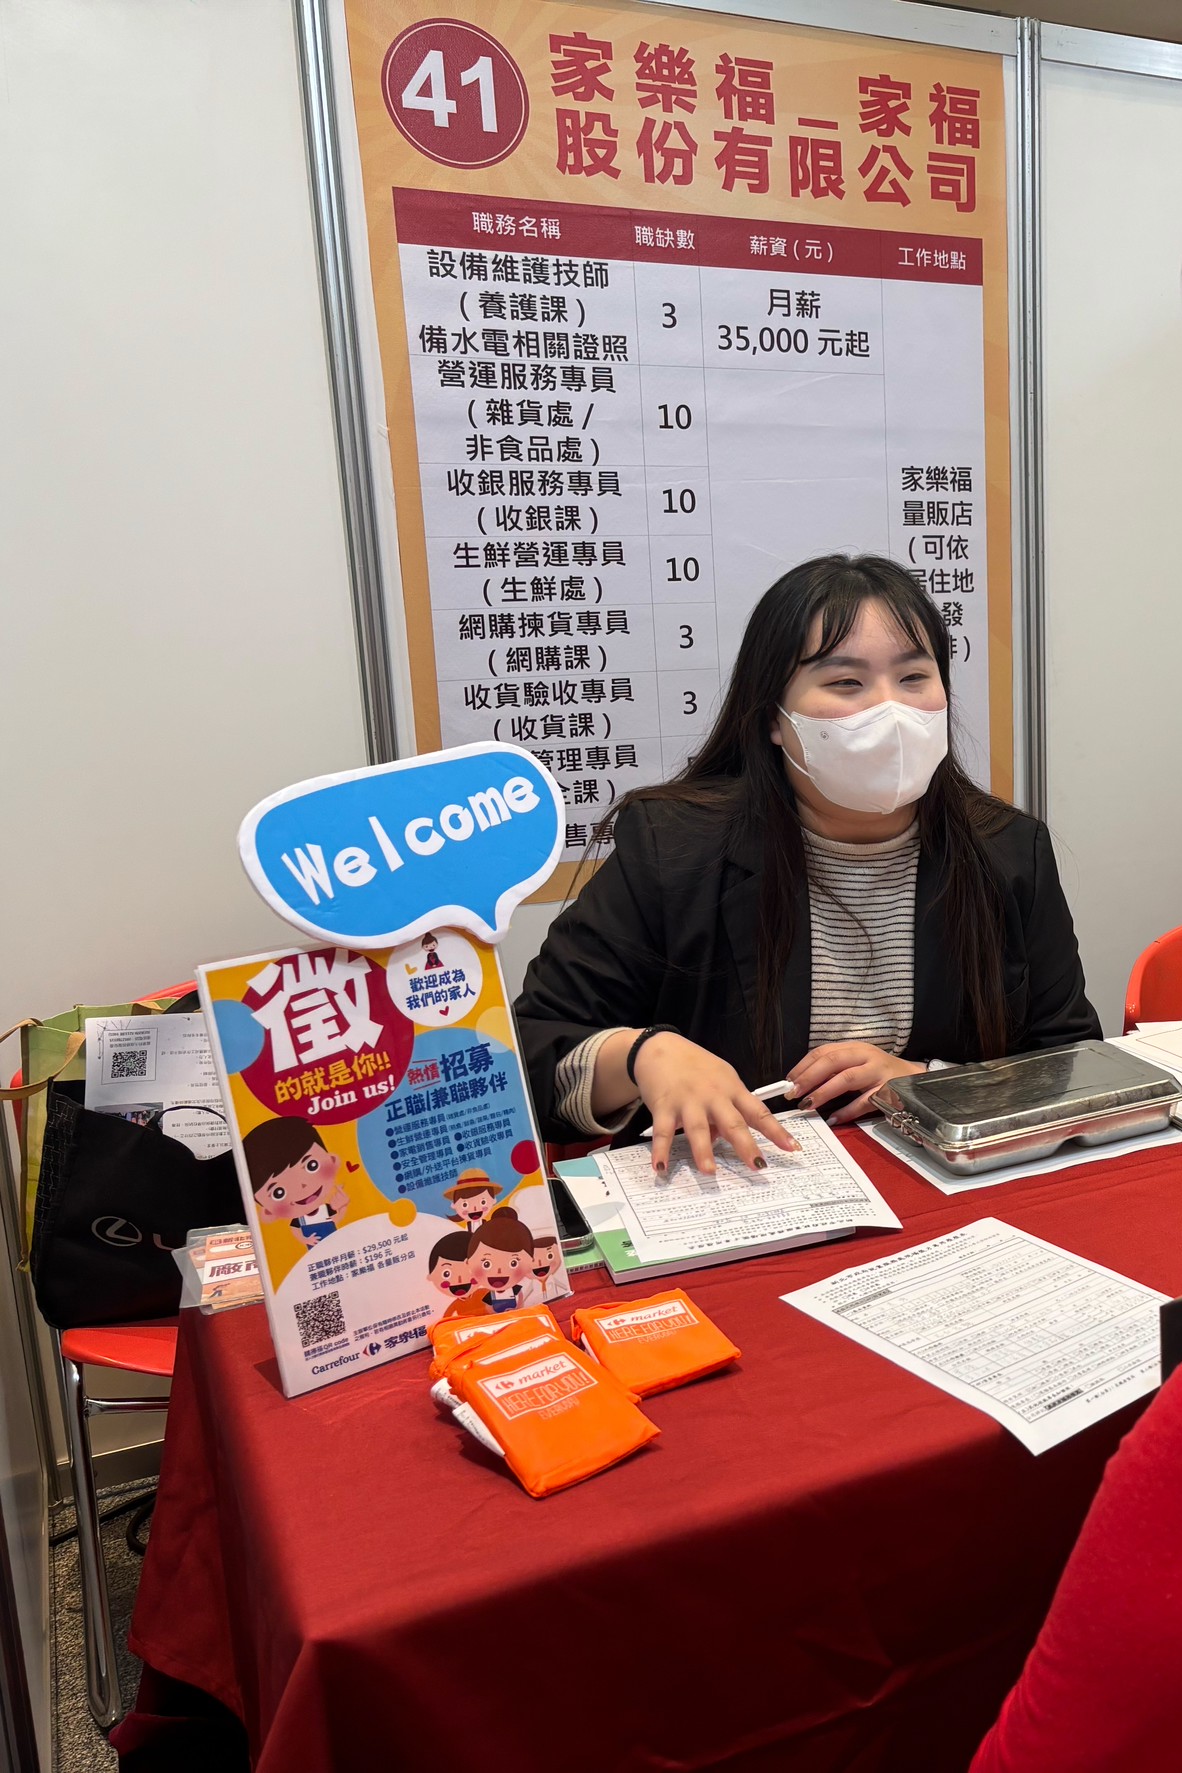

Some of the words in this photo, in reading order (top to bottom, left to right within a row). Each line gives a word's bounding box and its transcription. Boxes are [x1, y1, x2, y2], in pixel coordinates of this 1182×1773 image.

[401, 50, 499, 133] 41
[555, 108, 977, 213] 股份有限公司
[472, 211, 562, 240] 職務名稱
[634, 225, 696, 250] 職缺數
[427, 249, 610, 290] 設備維護技師
[897, 247, 967, 271] 工作地點
[459, 290, 586, 328] (養護課)
[662, 303, 678, 329] 3
[767, 290, 821, 320] 月薪
[419, 326, 629, 363] 備水電相關證照
[717, 326, 810, 357] 35,000
[817, 328, 871, 359] 元起
[438, 360, 616, 395] 營運服務專員
[657, 404, 693, 432] 10
[465, 435, 601, 467] 非食品處)
[446, 469, 623, 497] 收銀服務專員
[901, 465, 973, 493] 家樂福
[662, 488, 696, 515] 10
[902, 500, 973, 527] 量販店
[477, 504, 599, 536] (收銀課)
[452, 540, 627, 570] 生鮮營運專員
[908, 534, 969, 563] (可依
[665, 557, 700, 583] 10
[482, 574, 603, 606] (生鮮處)
[458, 610, 630, 641] 網購揀貨專員
[678, 625, 695, 649] 3
[487, 643, 608, 678] (網購課)
[463, 677, 636, 712] 收貨驗收專員
[681, 691, 698, 716] 3
[493, 713, 612, 742] (收貨課)
[281, 776, 540, 905] Welcome
[409, 969, 467, 993] 歡迎成為
[246, 948, 384, 1073] 徵
[406, 984, 476, 1011] 我們的家人
[274, 1051, 392, 1104] 的就是你!!
[408, 1062, 441, 1085] 熱情
[439, 1042, 494, 1083] 招募
[307, 1089, 358, 1115] Join
[364, 1074, 396, 1102] us!
[385, 1071, 509, 1122] 正職/兼職夥伴
[630, 1305, 679, 1322] market
[311, 1350, 361, 1376] Carrefour
[518, 1360, 567, 1385] market
[500, 1388, 535, 1415] HERE
[534, 1382, 560, 1406] FOR
